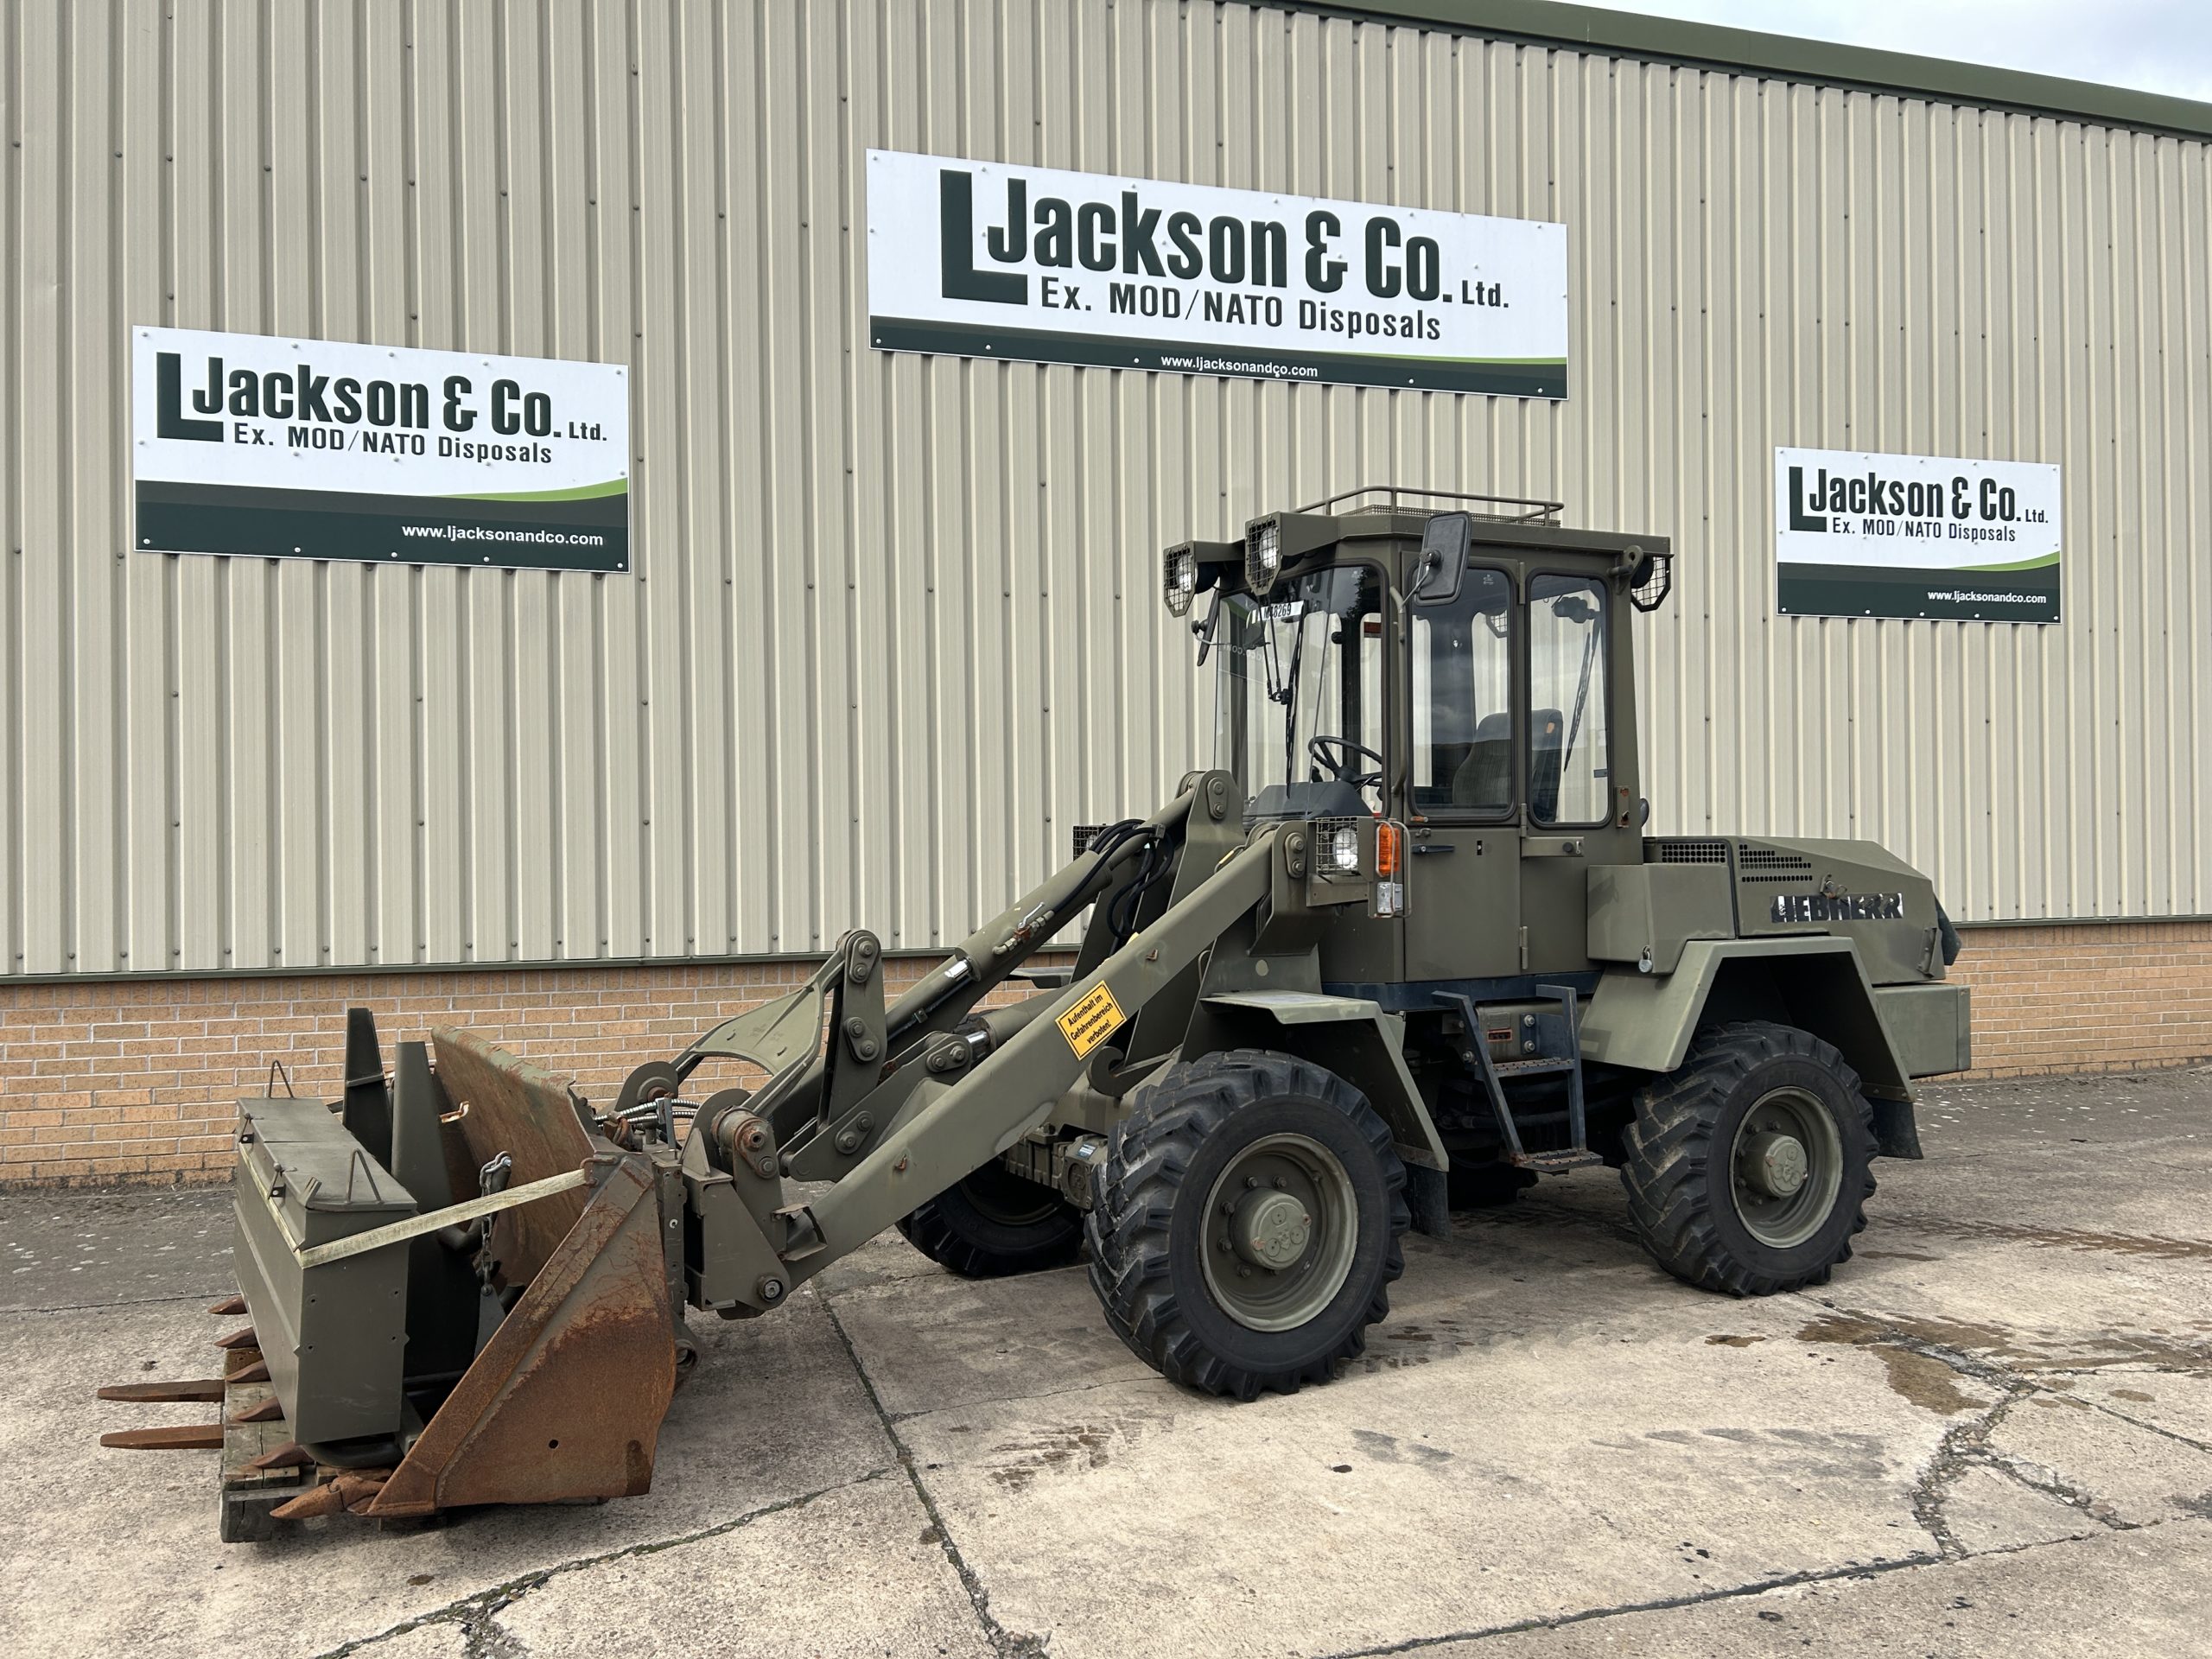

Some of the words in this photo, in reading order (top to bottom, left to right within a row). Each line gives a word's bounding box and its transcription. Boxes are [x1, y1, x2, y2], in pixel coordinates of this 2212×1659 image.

[1305, 210, 1349, 295] &
[1364, 216, 1453, 304] Co.
[1461, 279, 1510, 308] Ltd.
[1041, 276, 1091, 312] Ex.
[1109, 282, 1282, 327] MOD/NATO
[1299, 299, 1440, 340] Disposals
[1160, 355, 1319, 378] www.ljacksonandco.com
[443, 375, 478, 433] &
[491, 378, 562, 438] Co.
[569, 421, 607, 442] Ltd.
[234, 422, 274, 447] Ex.
[288, 425, 425, 456] MOD/NATO
[438, 435, 552, 464] Disposals
[1951, 476, 1972, 520] &
[1980, 478, 2021, 522] Co.
[2025, 509, 2049, 524] Ltd.
[402, 524, 603, 546] www.ljacksonandco.com
[1833, 517, 1855, 534] Ex.
[1862, 518, 1942, 538] MOD/NATO
[1948, 523, 2016, 543] Disposals
[1927, 590, 2047, 604] www.ljacksonandco.com
[1067, 1000, 1096, 1027] Aufenthalt
[1094, 995, 1103, 1004] im
[1070, 1001, 1114, 1040] Gefahrenbereich
[1086, 1020, 1112, 1045] verboten!
